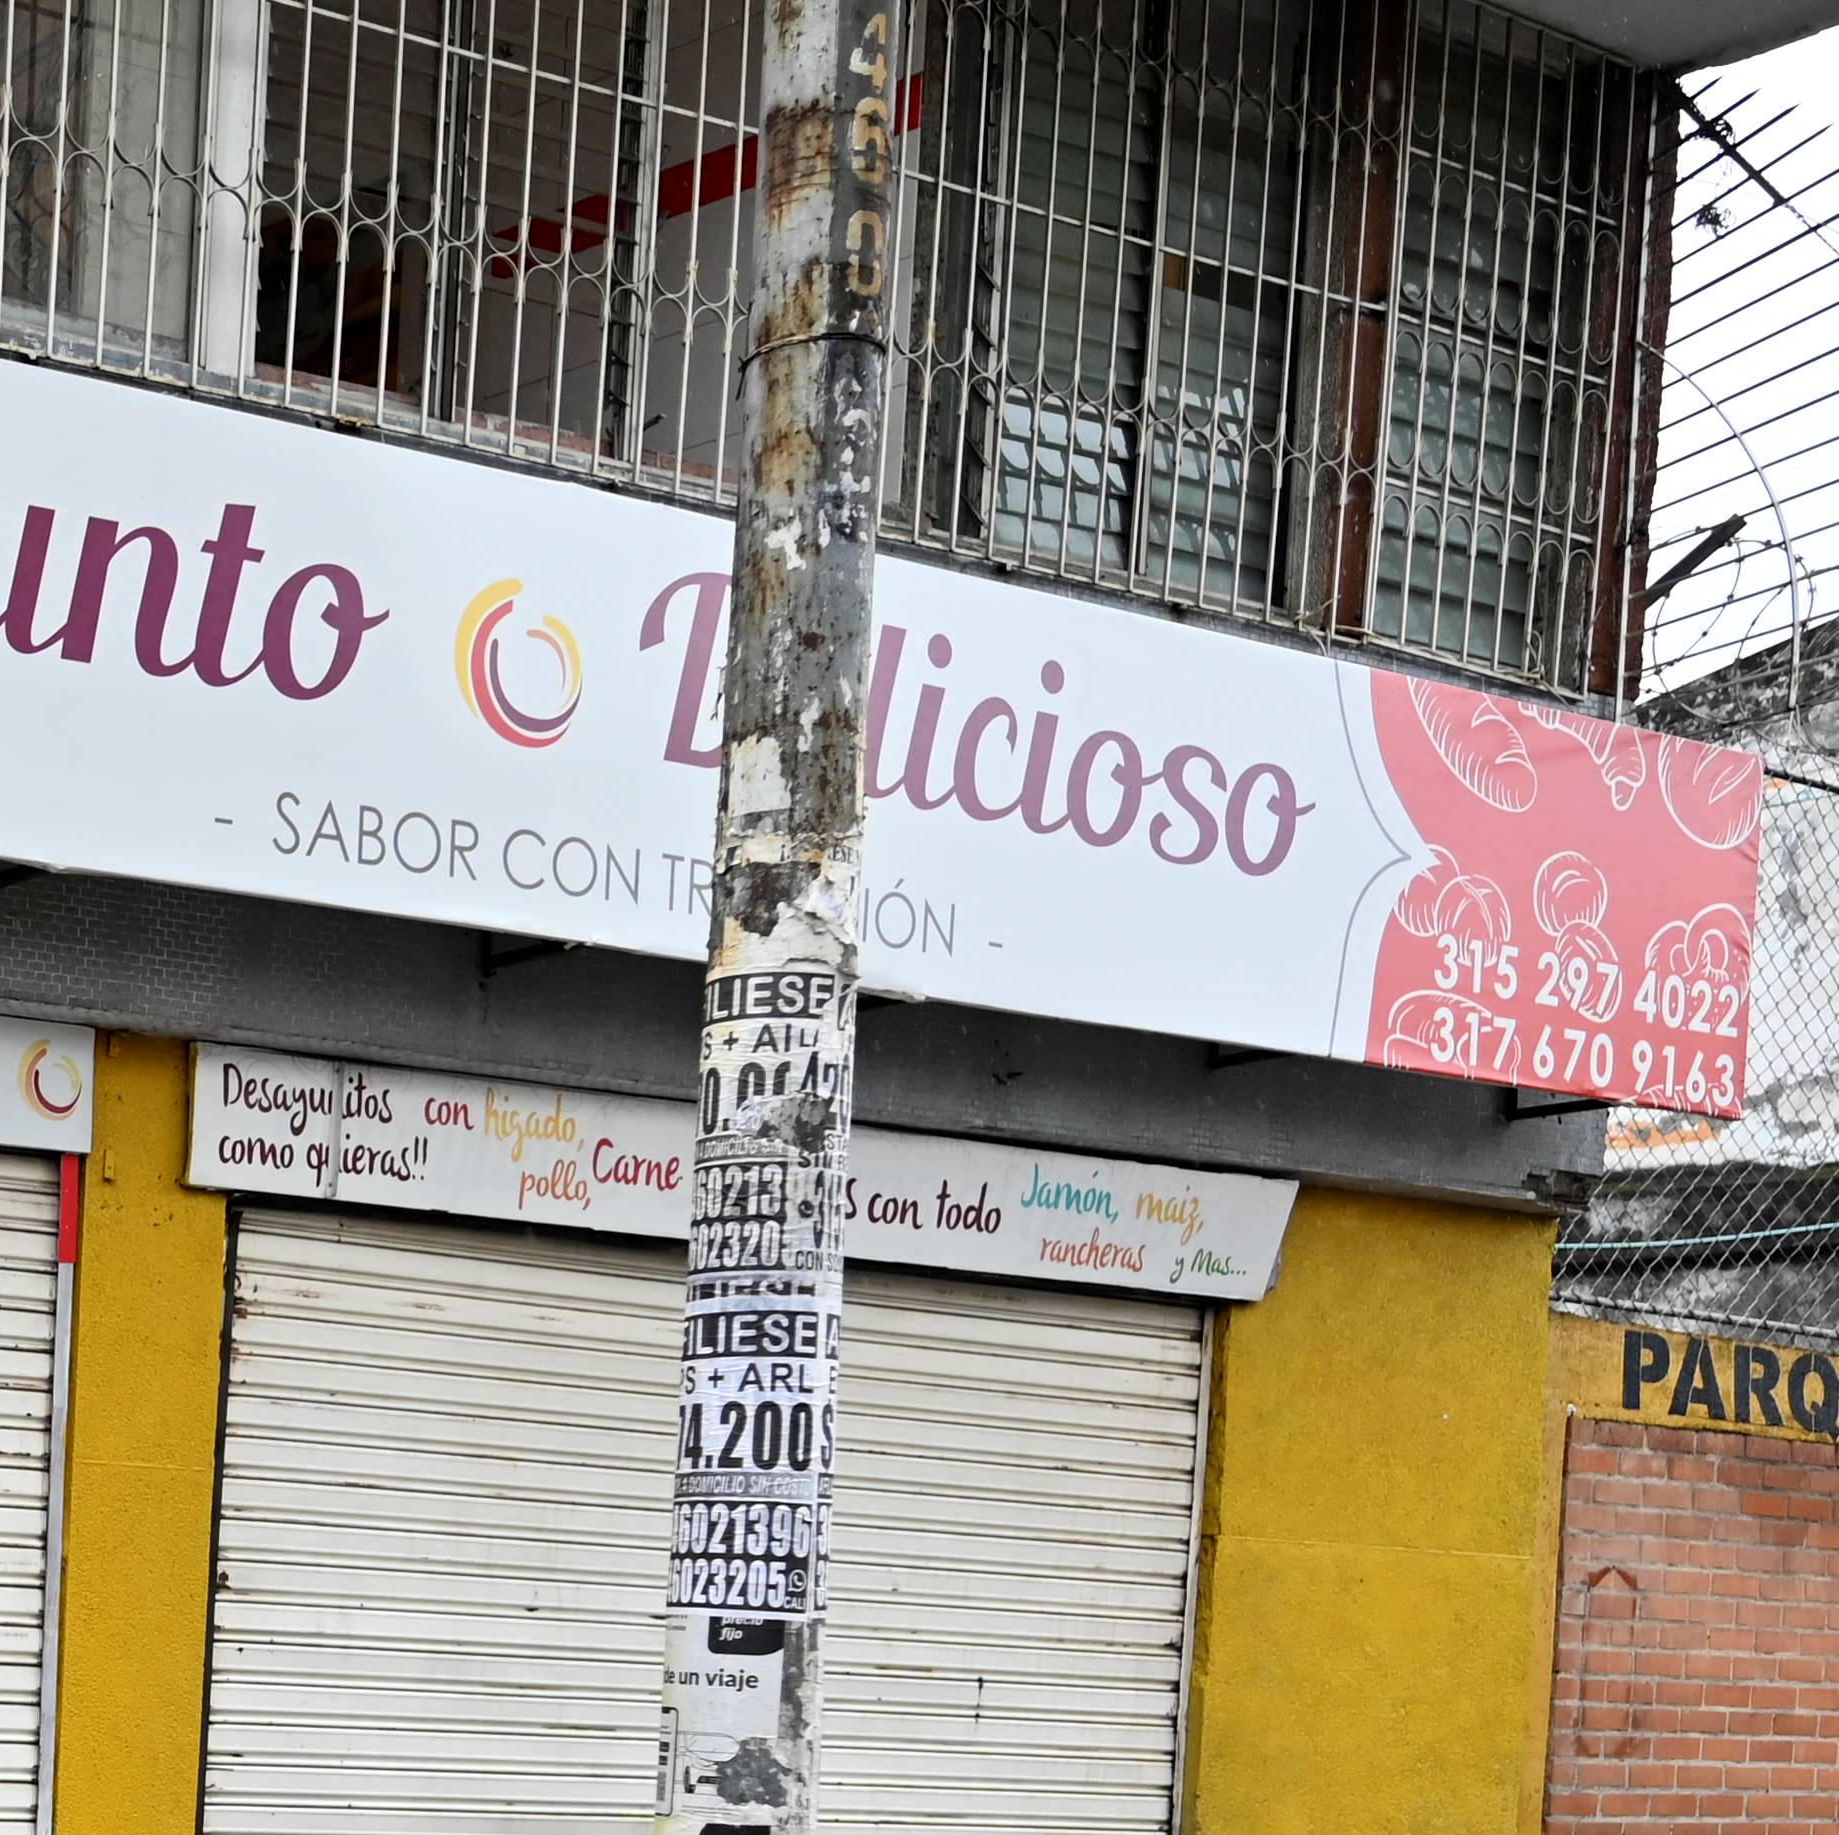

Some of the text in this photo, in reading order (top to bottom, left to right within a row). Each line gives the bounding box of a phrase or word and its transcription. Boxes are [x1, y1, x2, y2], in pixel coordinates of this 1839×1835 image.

[640, 572, 1315, 877] Dlicioso
[272, 791, 956, 955] SABOR CON TRIÓN
[1433, 933, 1740, 1039] 315 297 4022
[1430, 1006, 1736, 1106] 317 670 9163
[222, 1063, 394, 1137] Desayuitos
[424, 1095, 475, 1131] con
[218, 1133, 295, 1170] como
[592, 1137, 684, 1191] Carne
[517, 1159, 593, 1211] pollo,
[866, 1190, 924, 1231] con
[935, 1179, 1002, 1235] todo
[1020, 1163, 1122, 1225] Jamón,
[1038, 1226, 1147, 1274] rancheras
[1173, 1251, 1187, 1285] y
[738, 1362, 815, 1394] ARL
[1623, 1329, 1839, 1440] PARQ
[783, 1596, 807, 1610] CALI
[719, 1627, 743, 1641] fijo
[678, 1670, 700, 1687] un
[705, 1668, 759, 1692] viaje
